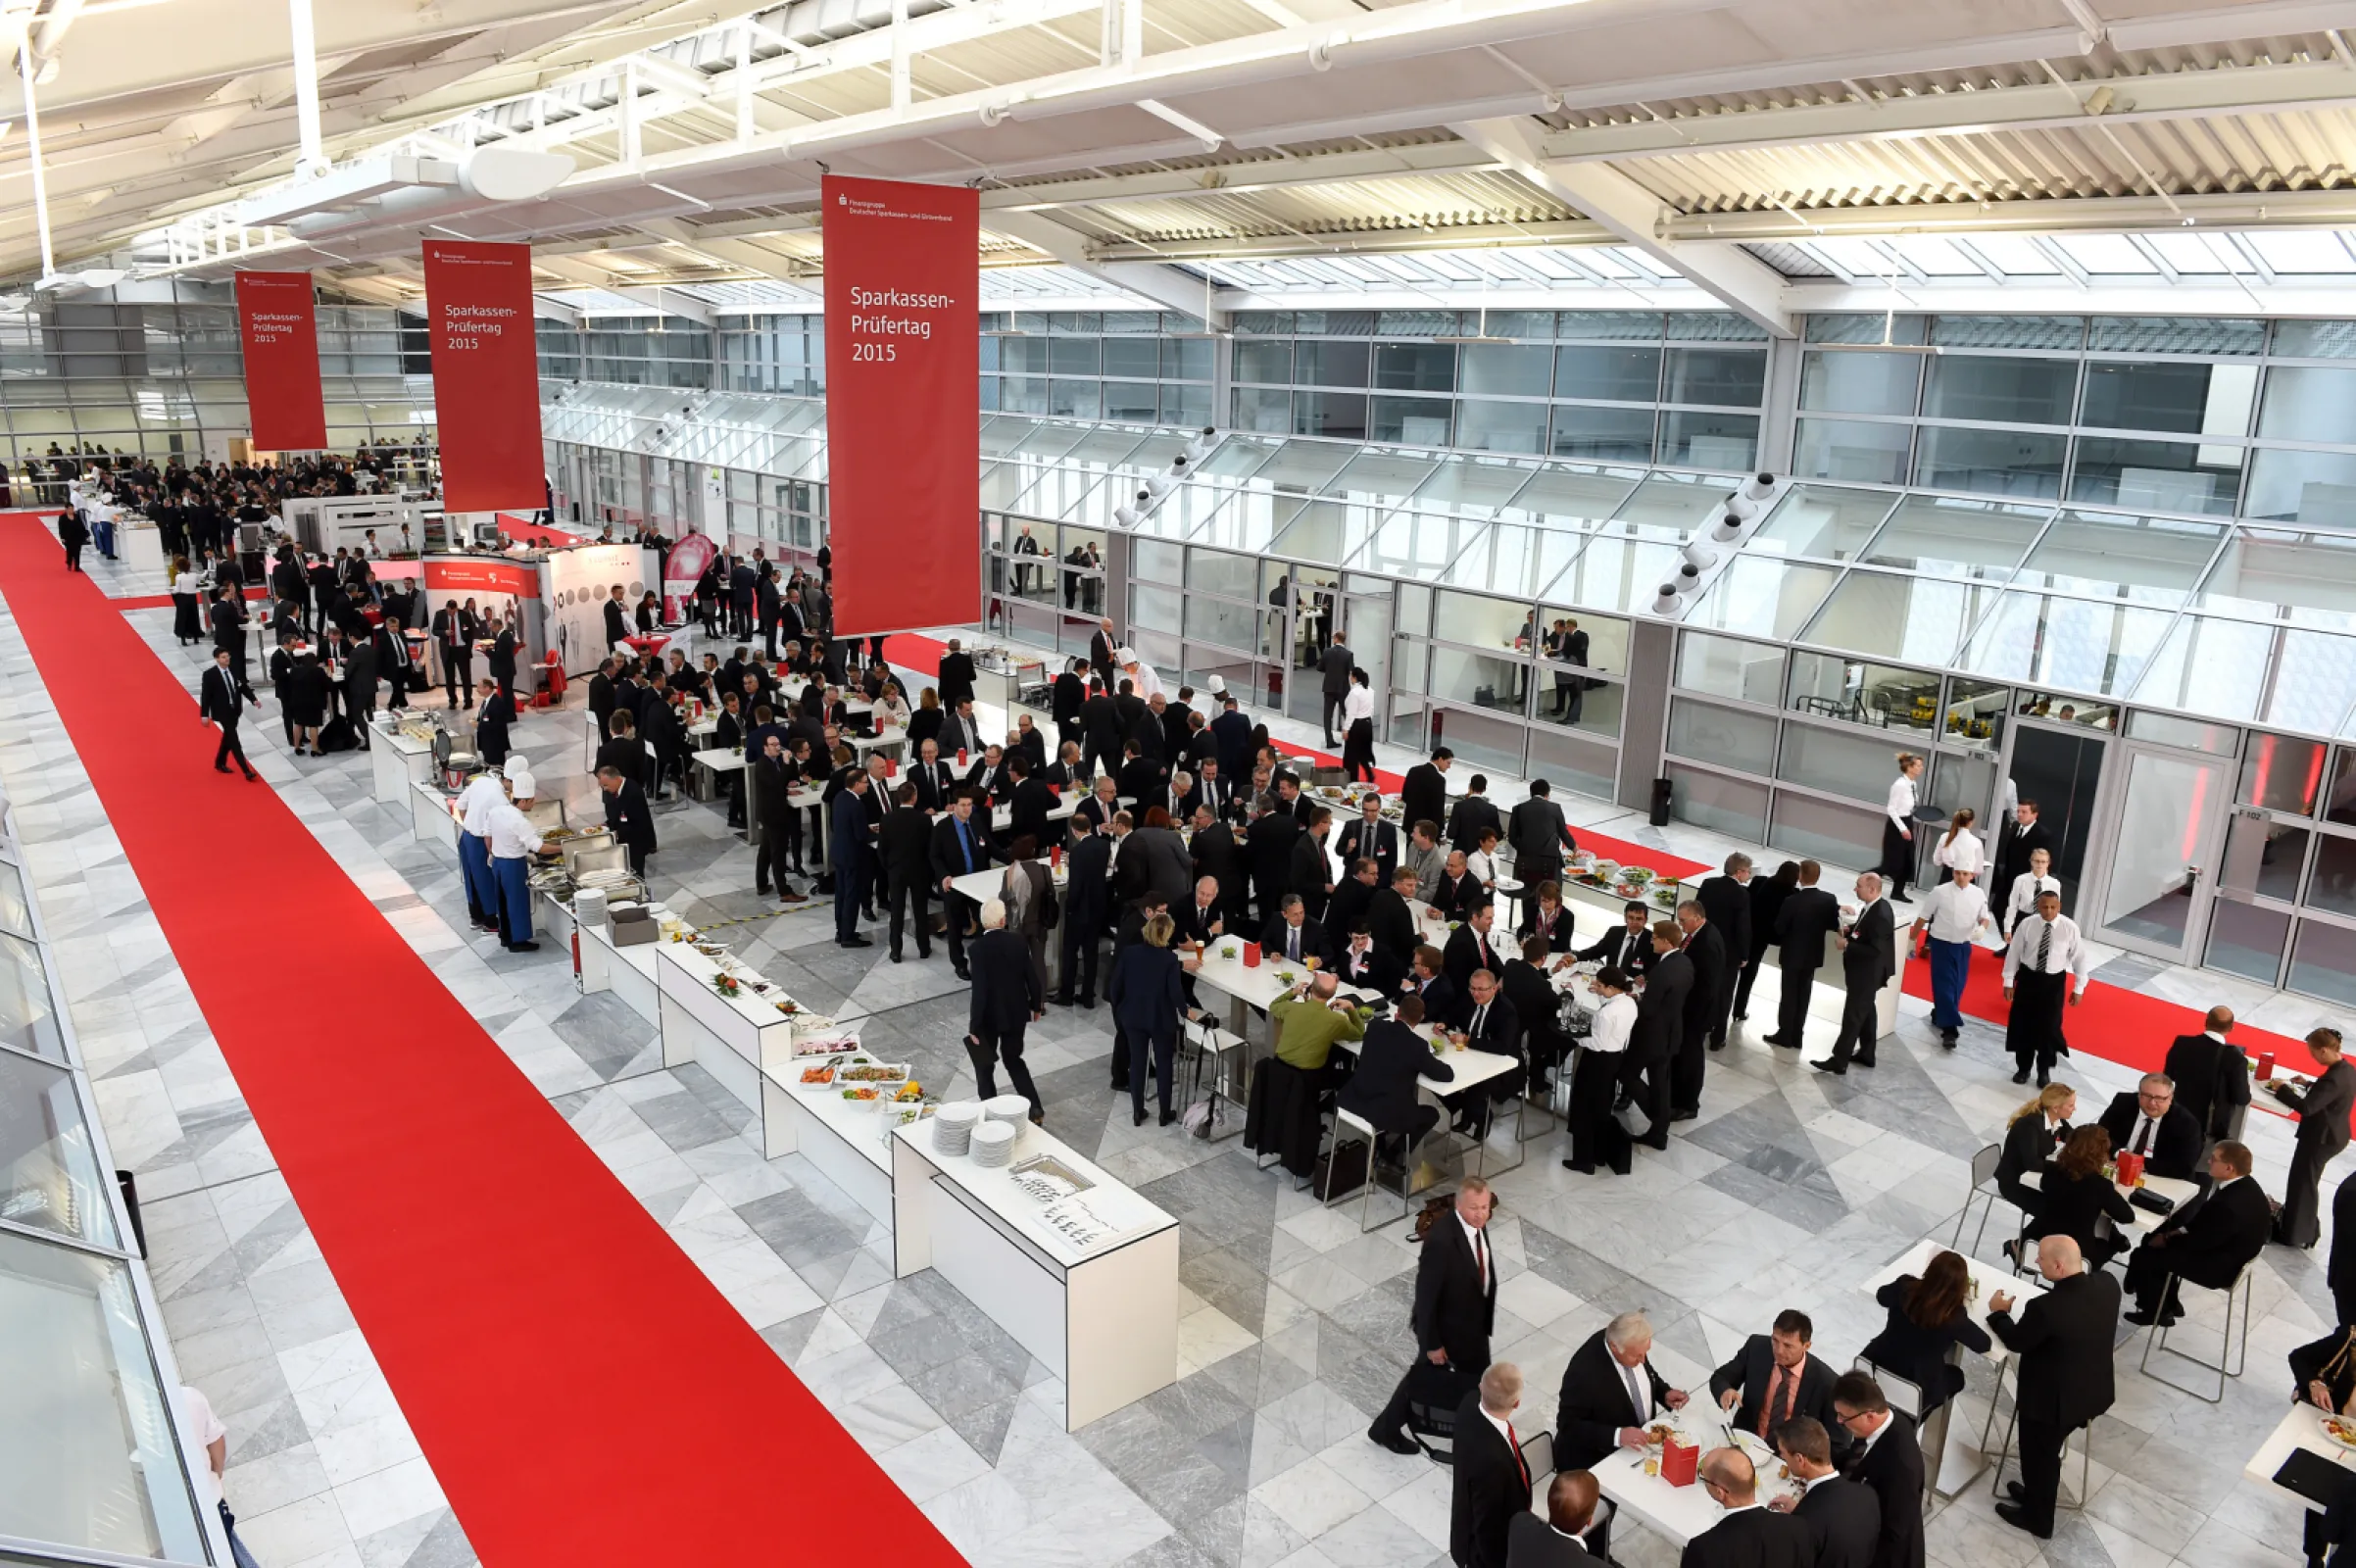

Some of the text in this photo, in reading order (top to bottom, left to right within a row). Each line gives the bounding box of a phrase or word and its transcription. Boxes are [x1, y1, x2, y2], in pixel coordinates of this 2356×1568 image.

[849, 207, 877, 216] Deutscher
[850, 286, 956, 310] Sparkassen-
[251, 312, 303, 321] Sparkassen-
[445, 304, 517, 318] Sparkassen-
[252, 322, 292, 333] Prüfertag
[446, 320, 502, 336] Prüfertag
[852, 315, 931, 339] Prüfertag
[254, 333, 276, 343] 2015
[448, 337, 479, 350] 2015
[852, 342, 897, 362] 2015
